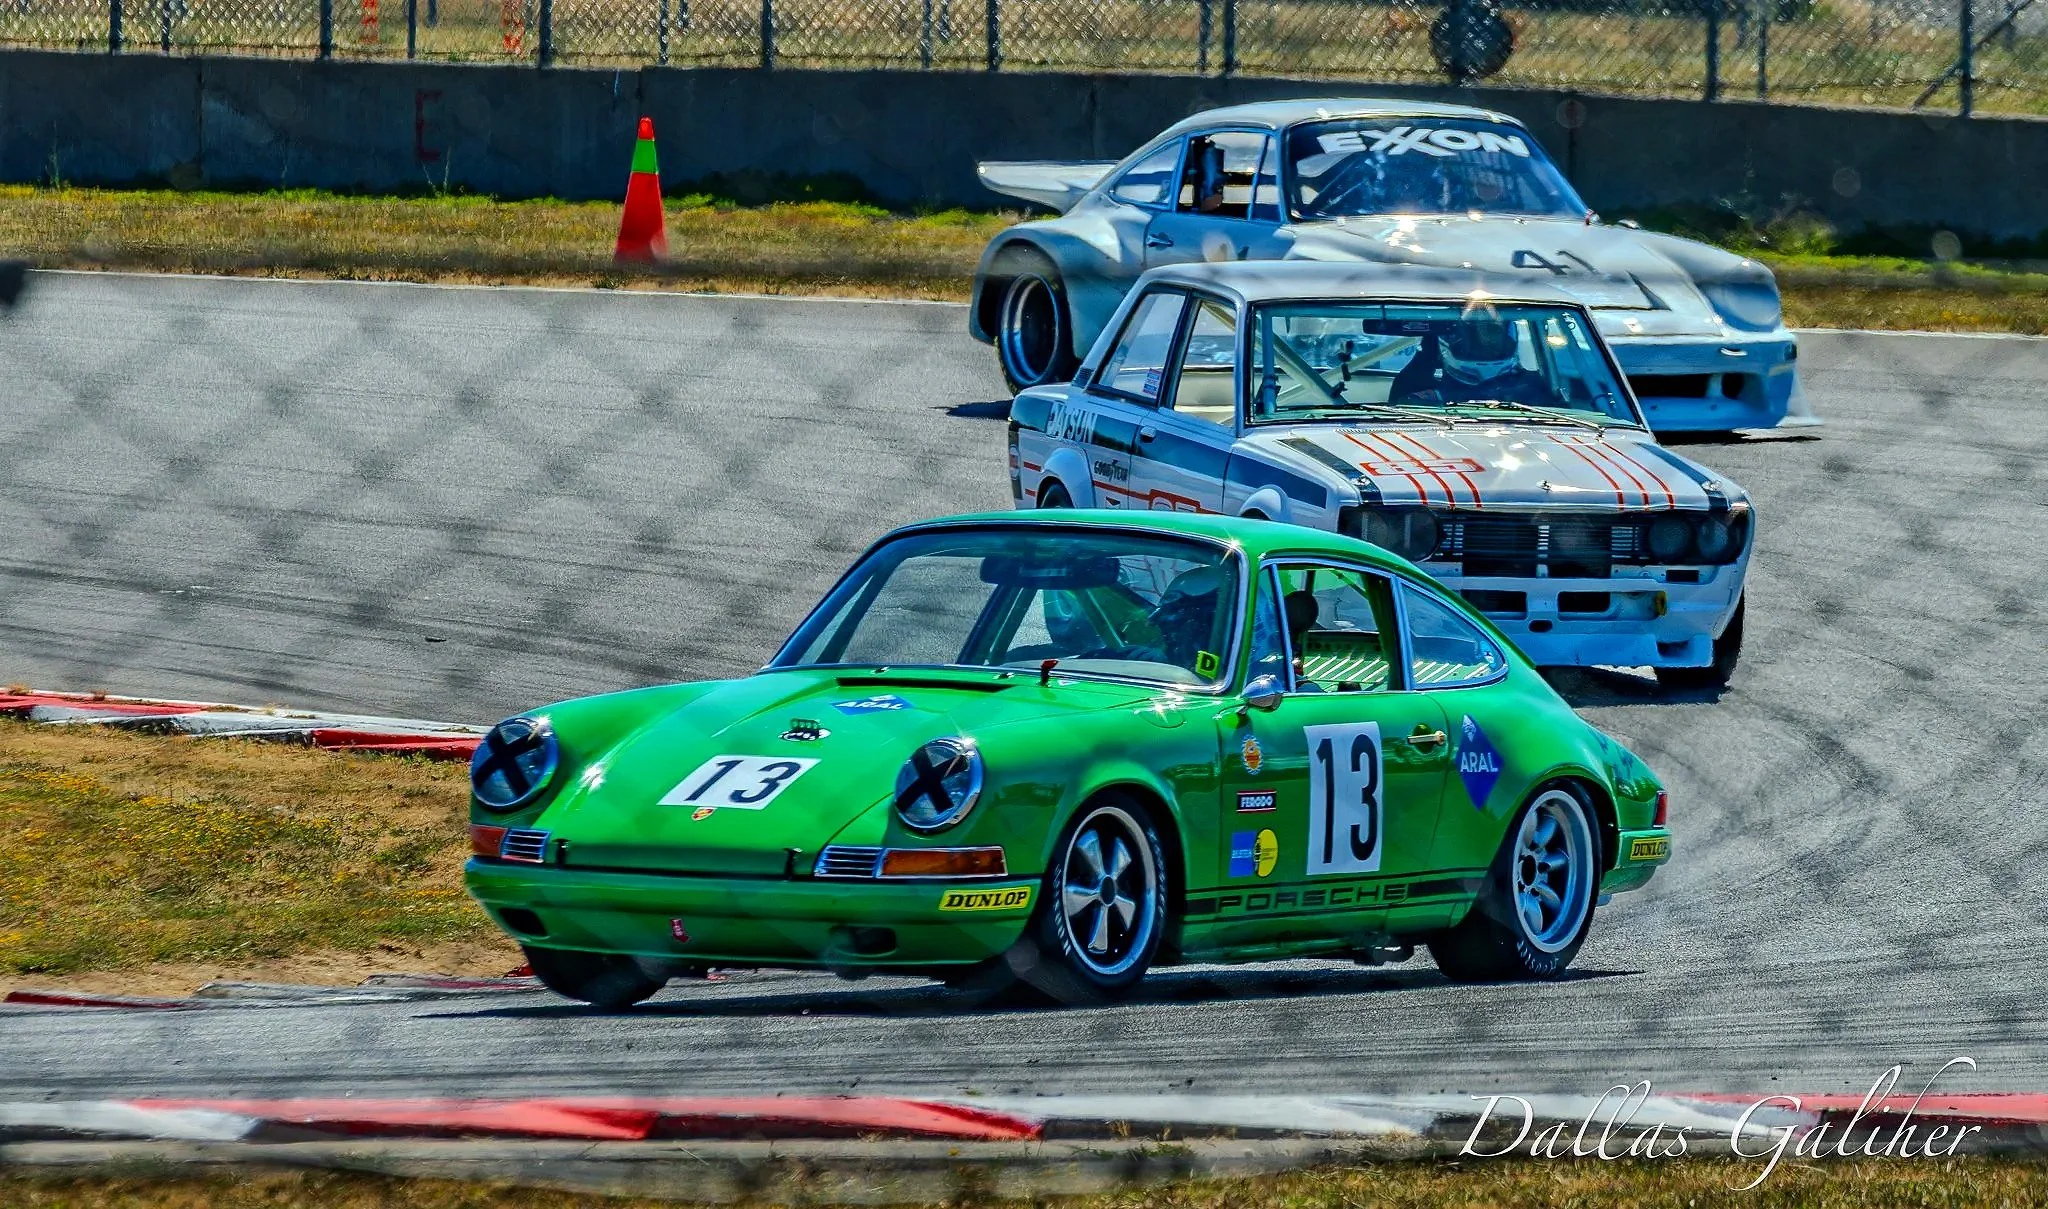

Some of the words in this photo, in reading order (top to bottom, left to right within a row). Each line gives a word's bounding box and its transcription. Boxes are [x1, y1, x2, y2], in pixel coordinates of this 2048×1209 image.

[1317, 126, 1529, 157] EXXON
[1200, 653, 1216, 672] D
[835, 701, 904, 710] ARAL
[1460, 751, 1499, 773] ARAL
[684, 759, 803, 804] 13
[1240, 795, 1274, 808] FERODO
[1316, 734, 1378, 864] 13
[944, 891, 1028, 908] DUNLOP
[1218, 884, 1408, 914] PORSCHE
